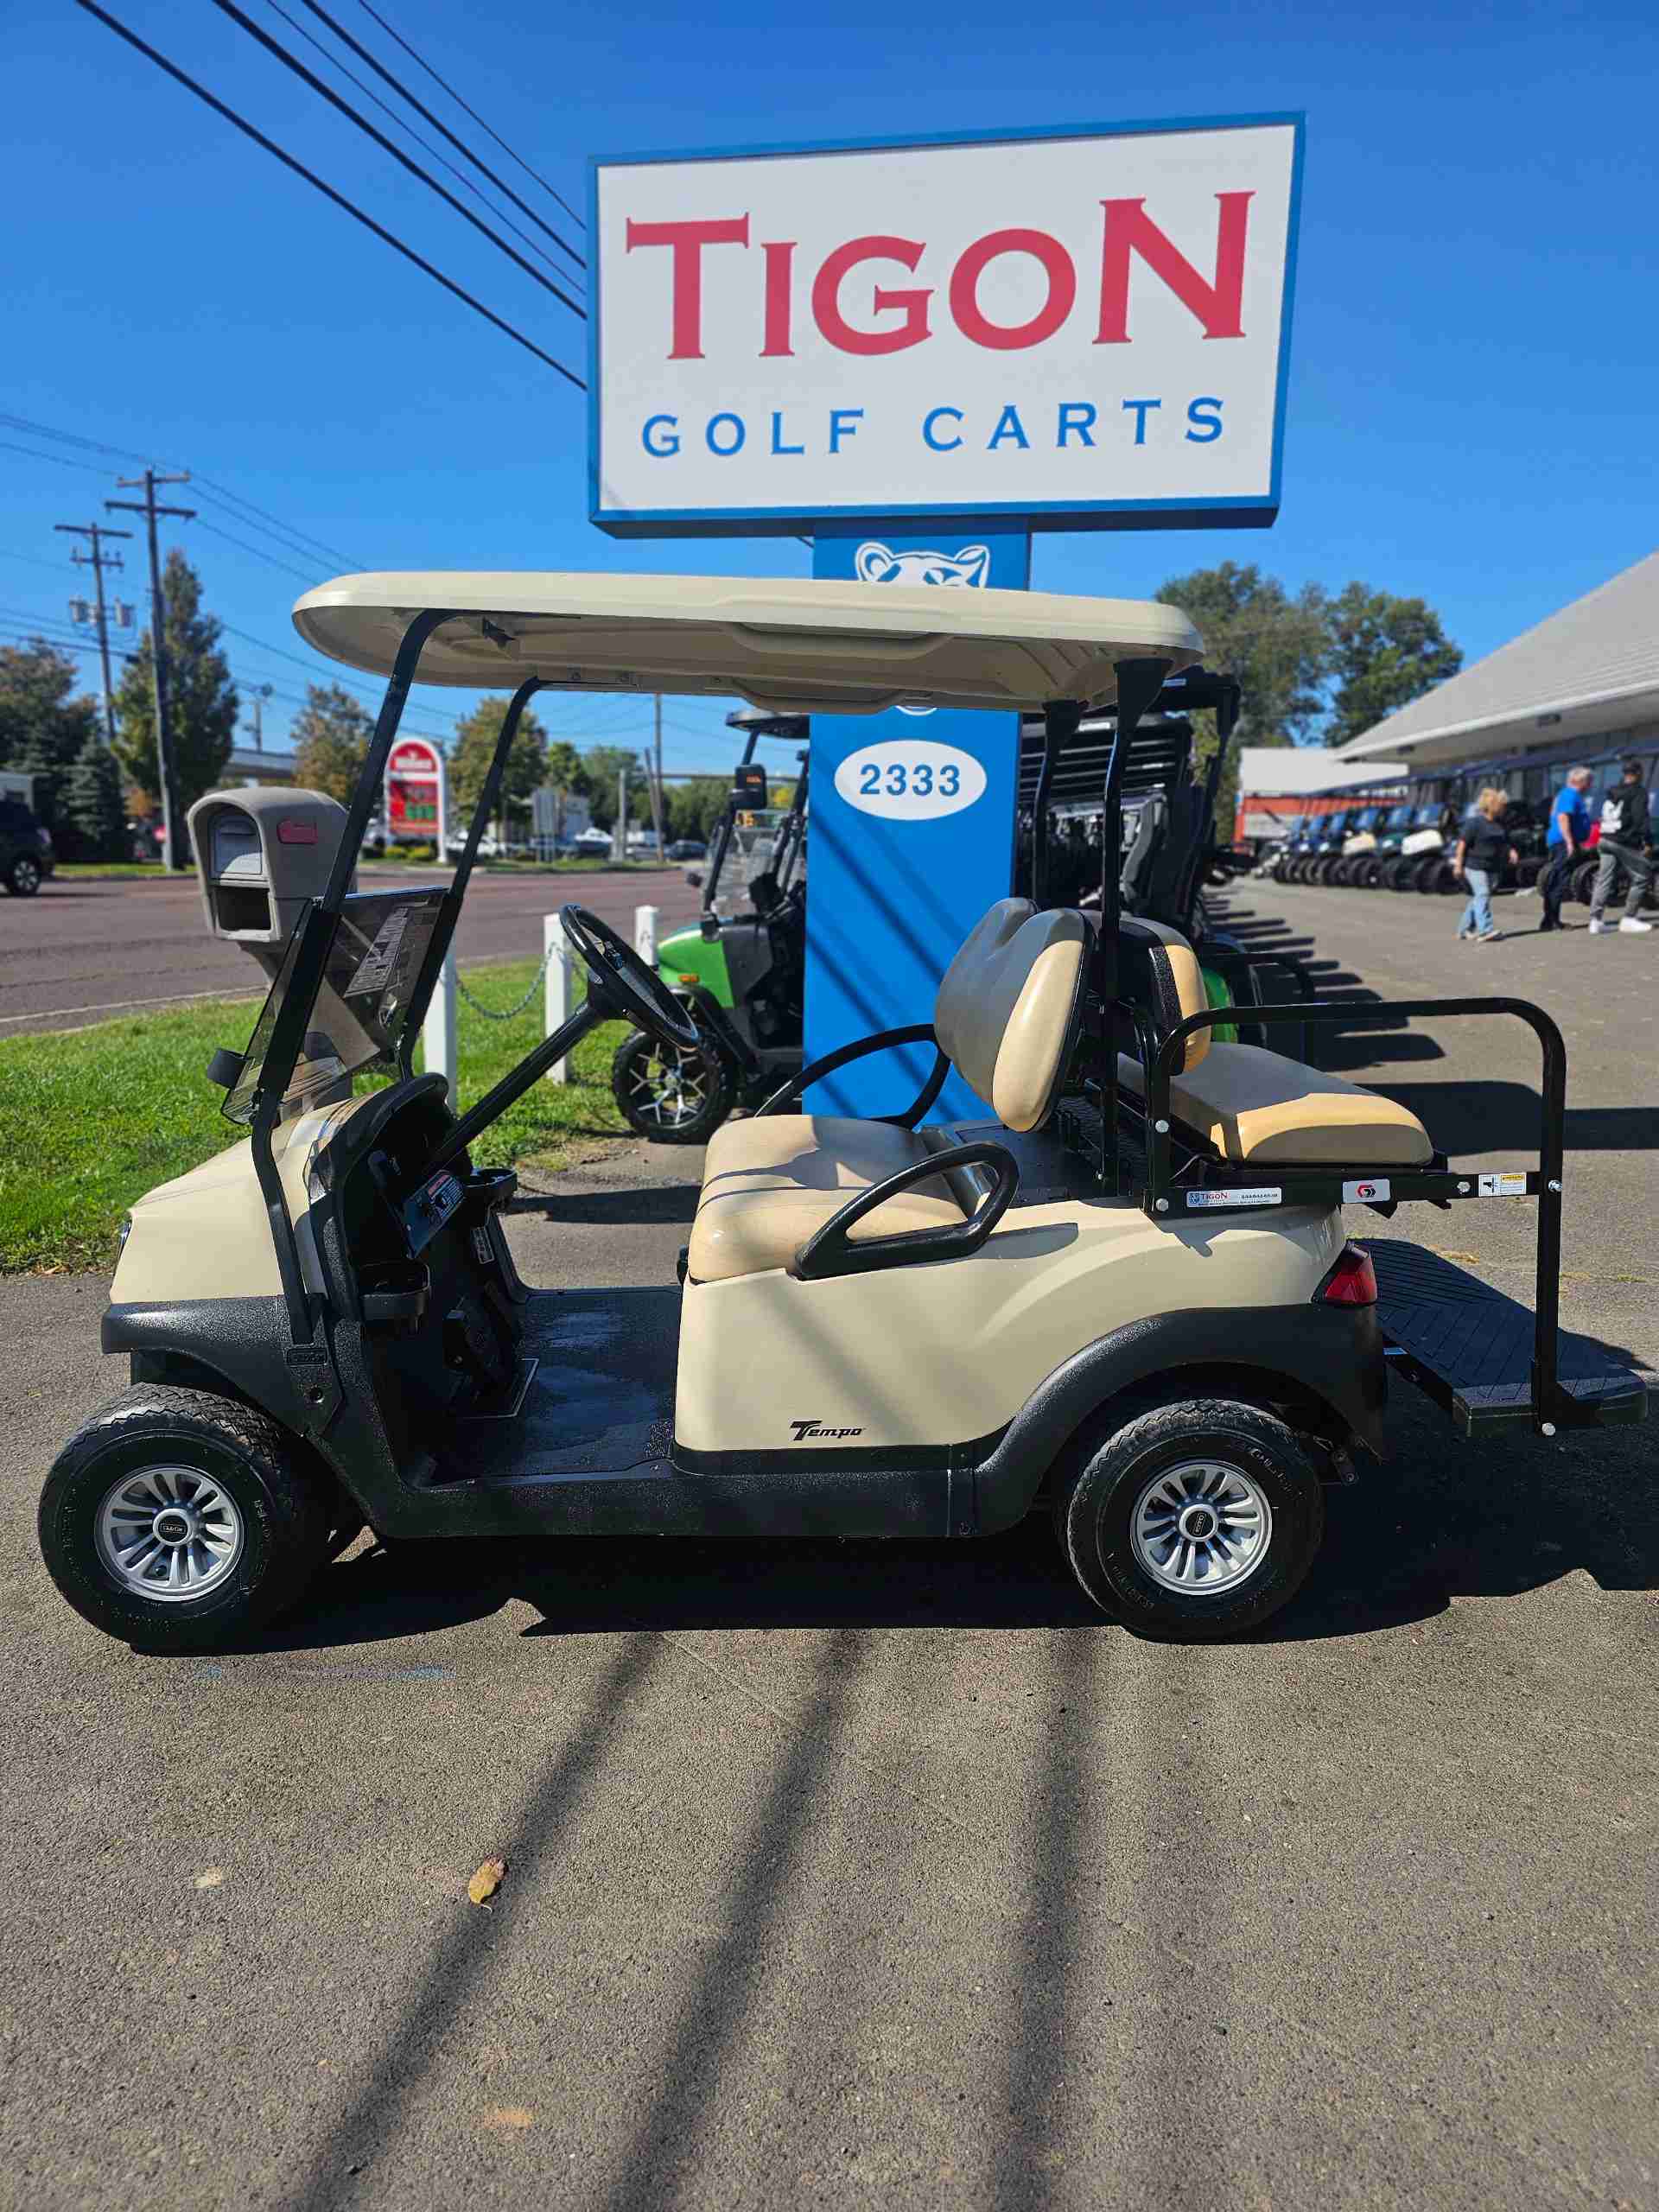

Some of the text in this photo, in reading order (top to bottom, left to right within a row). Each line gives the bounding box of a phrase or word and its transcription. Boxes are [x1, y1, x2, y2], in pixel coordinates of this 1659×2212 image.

[626, 189, 1258, 361] TIGON
[642, 395, 1225, 457] GOLF CARTS
[860, 763, 961, 797] 2333
[790, 1420, 862, 1441] Tempo
